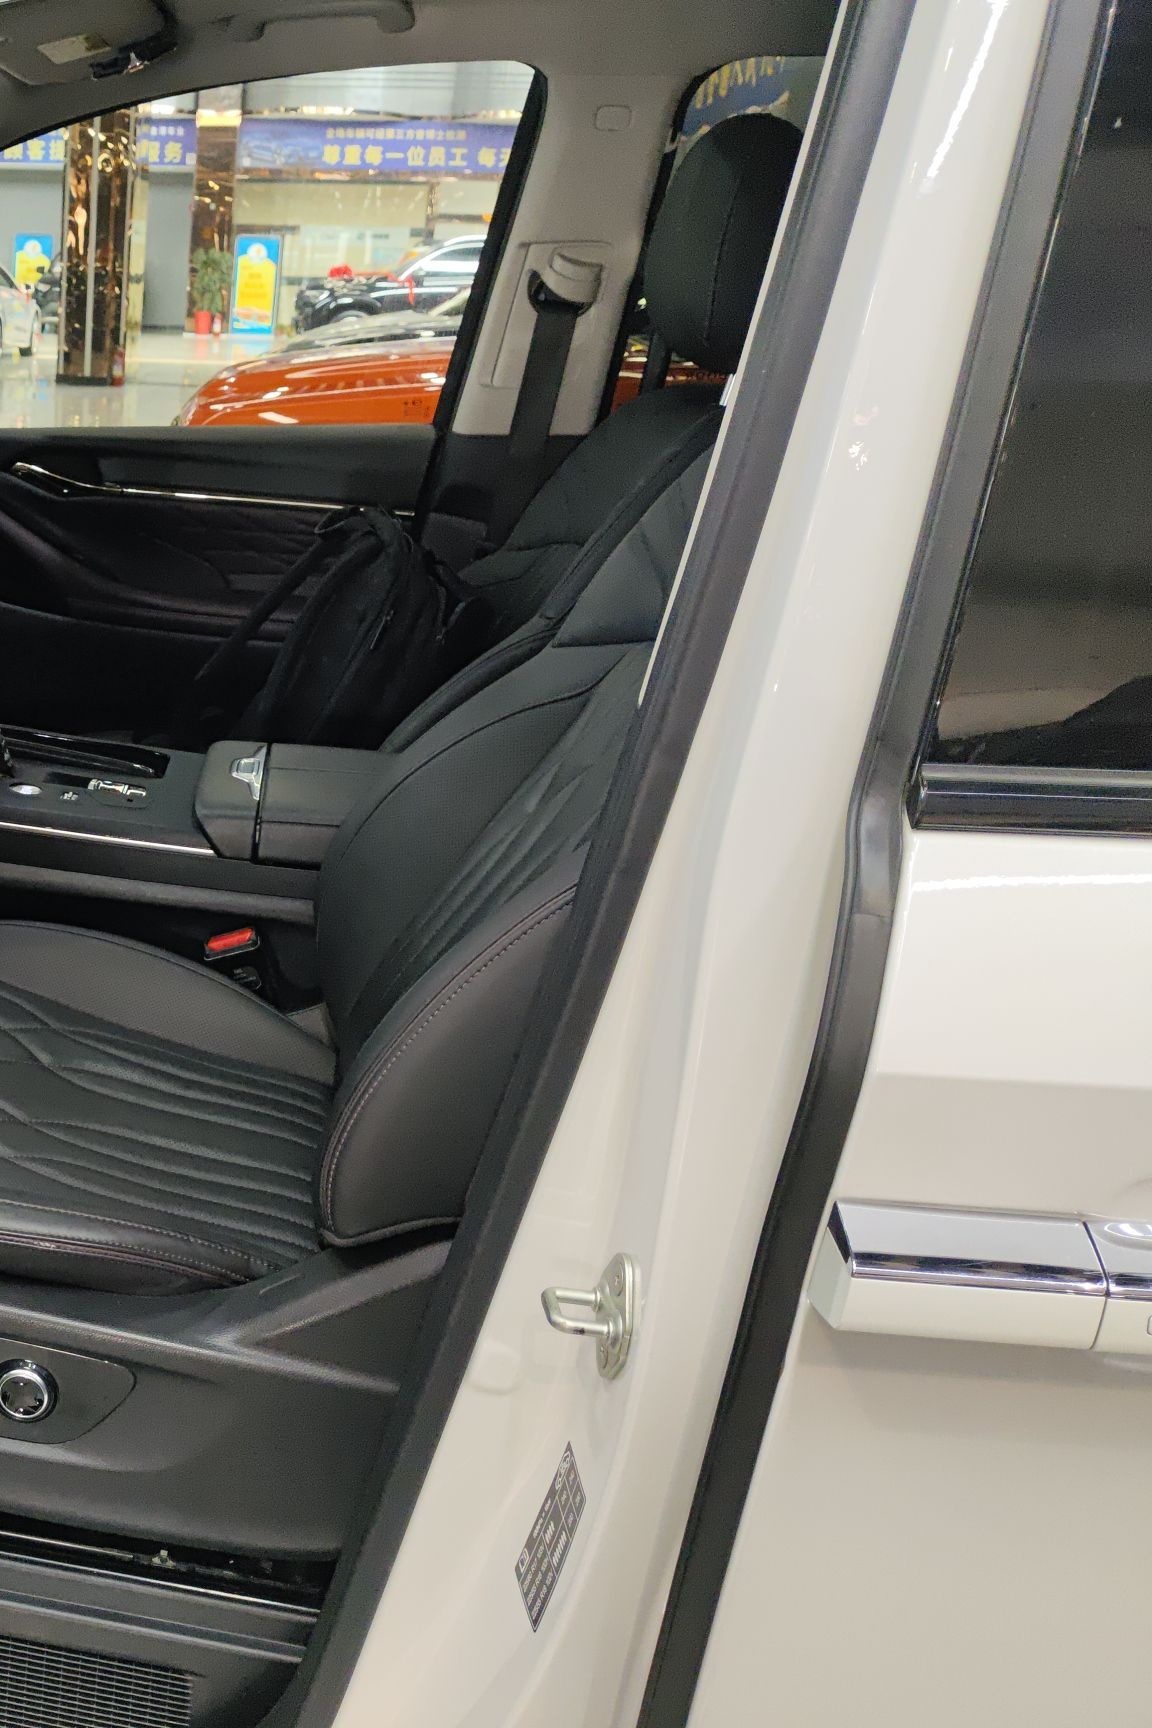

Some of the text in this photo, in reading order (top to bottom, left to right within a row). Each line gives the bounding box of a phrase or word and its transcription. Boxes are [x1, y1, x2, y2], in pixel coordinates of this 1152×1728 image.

[322, 144, 468, 167] 尊重每一位员工
